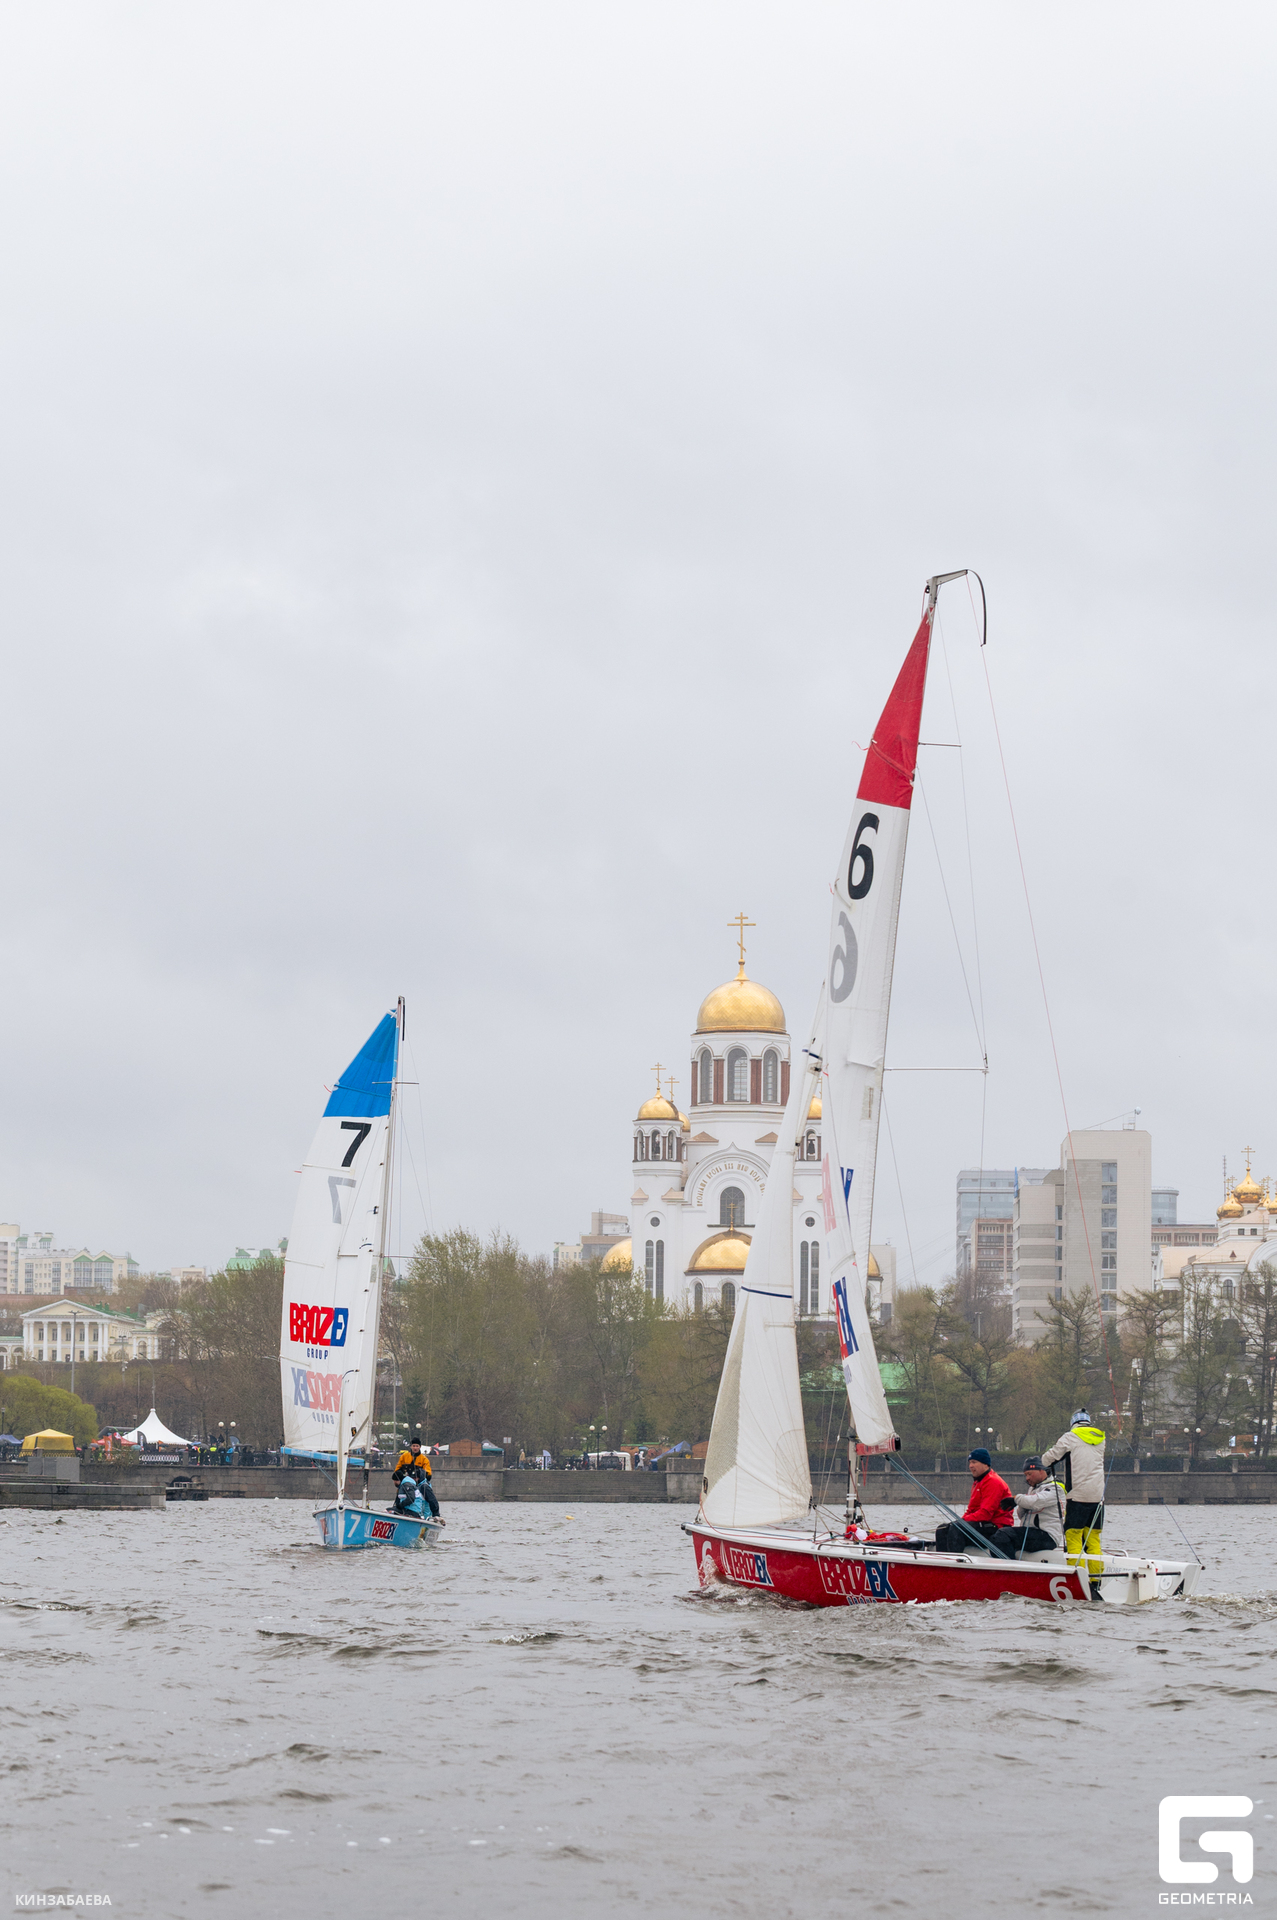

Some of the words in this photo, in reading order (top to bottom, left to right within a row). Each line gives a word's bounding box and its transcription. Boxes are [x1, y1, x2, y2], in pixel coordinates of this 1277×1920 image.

[848, 812, 880, 900] 6
[341, 1122, 371, 1167] 7
[306, 1348, 328, 1360] GROUP
[347, 1513, 361, 1538] 7
[370, 1519, 399, 1541] BROZEX
[729, 1547, 775, 1587] BROZEX
[817, 1555, 899, 1600] BROZEX
[1049, 1576, 1074, 1601] 6
